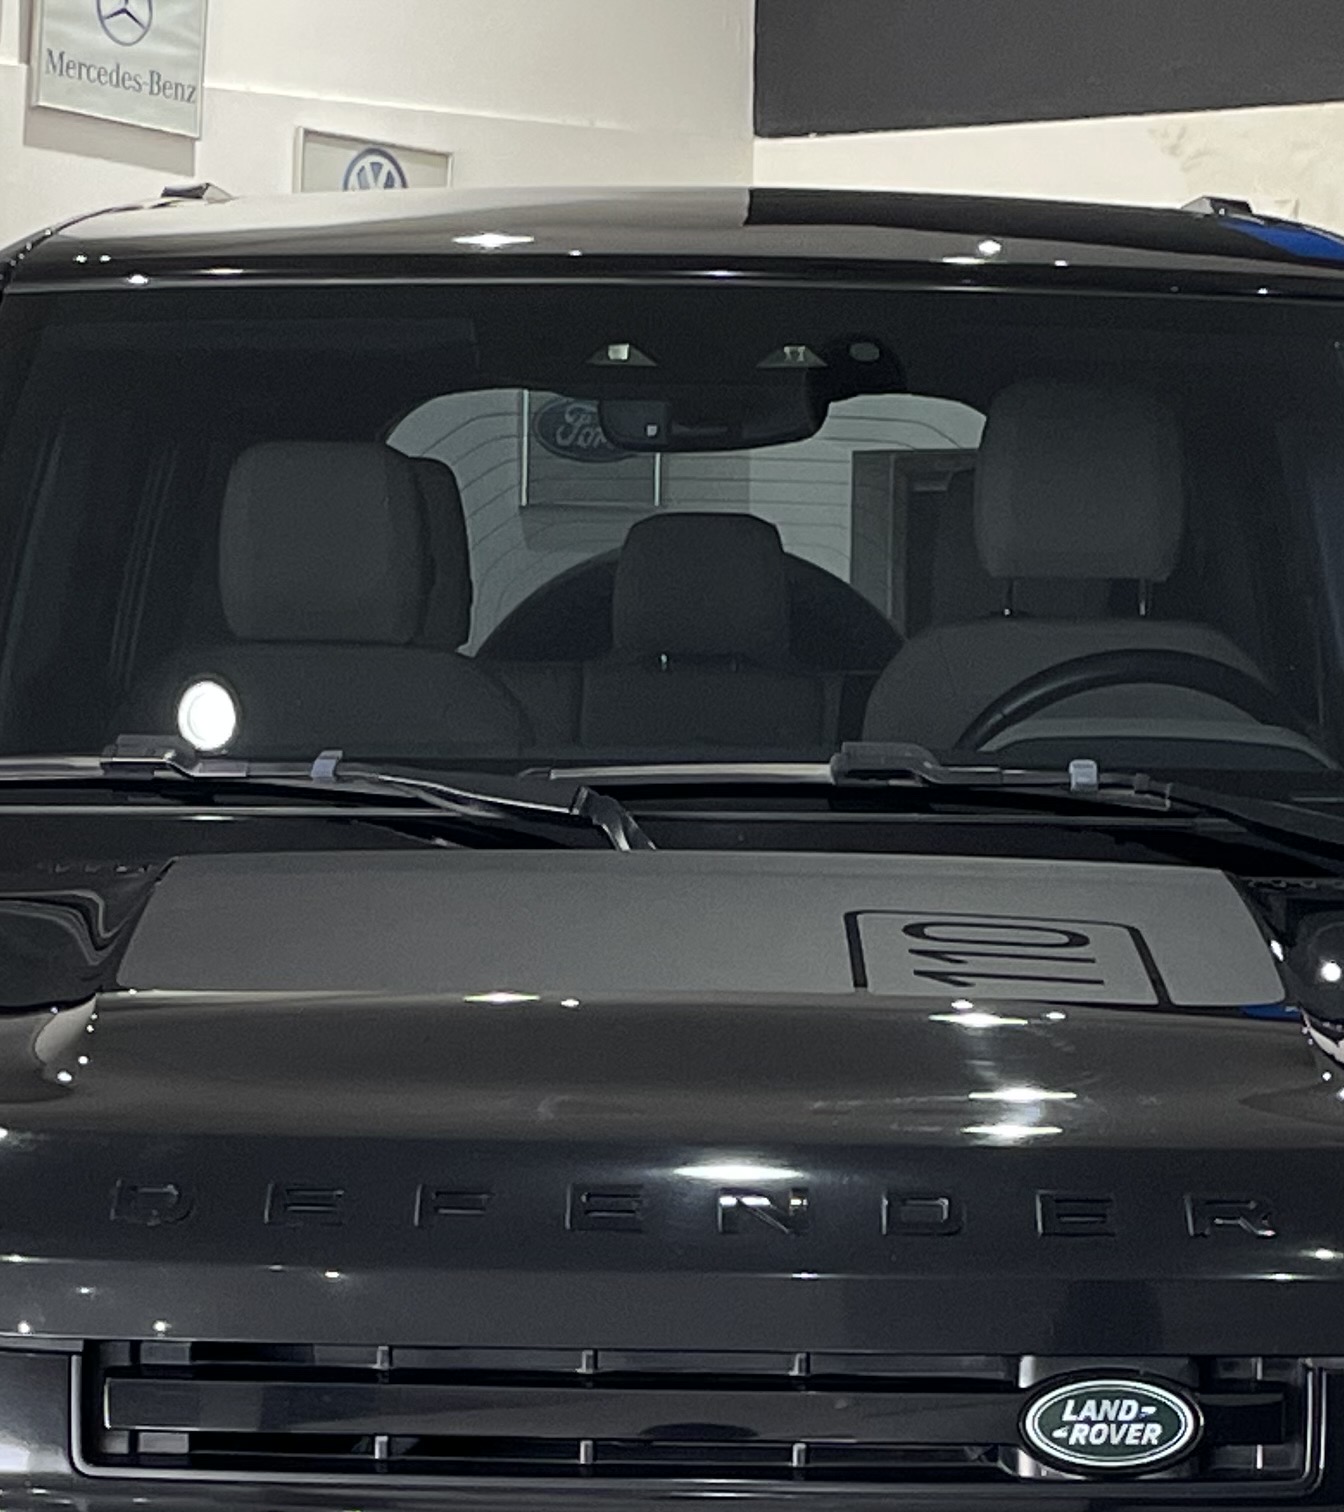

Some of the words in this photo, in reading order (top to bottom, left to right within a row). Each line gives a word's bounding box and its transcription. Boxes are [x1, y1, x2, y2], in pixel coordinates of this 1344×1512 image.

[44, 48, 198, 103] Mercedes-Benz
[556, 403, 613, 449] For
[901, 921, 1106, 989] 110
[109, 1178, 1278, 1238] DEFENDER
[1061, 1399, 1139, 1422] LAND
[1067, 1423, 1163, 1446] ROVER
